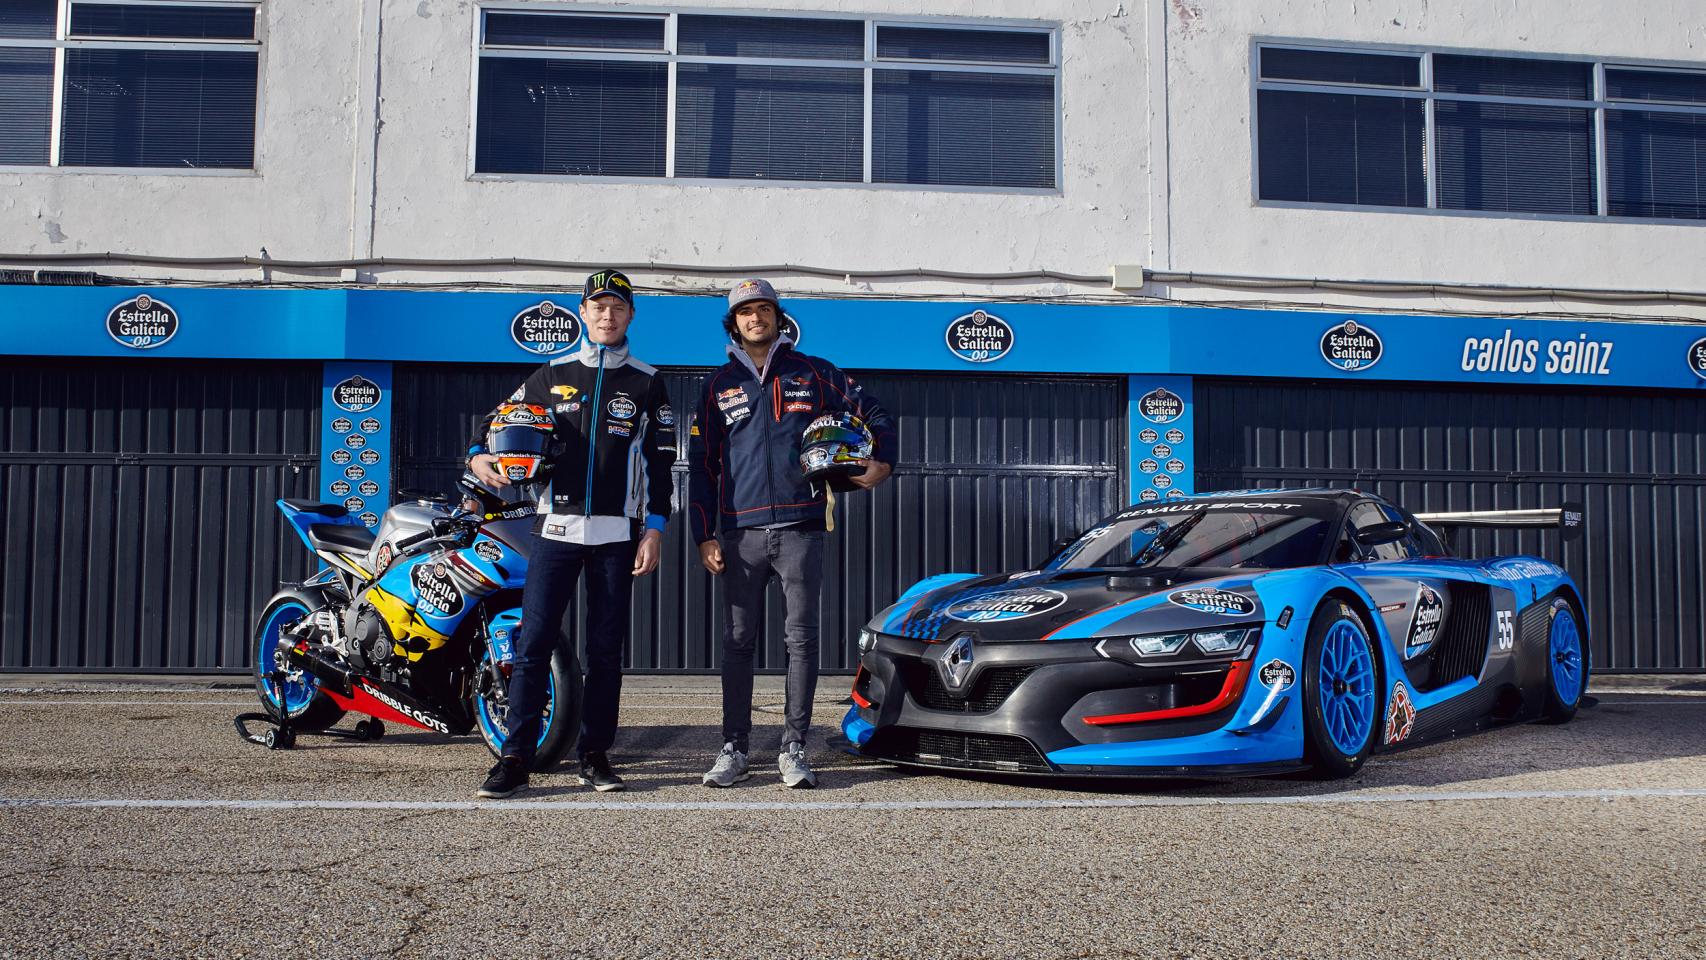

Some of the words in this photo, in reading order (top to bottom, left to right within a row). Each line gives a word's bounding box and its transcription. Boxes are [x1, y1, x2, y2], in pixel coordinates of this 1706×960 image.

[118, 309, 169, 323] Estrella
[522, 316, 572, 329] Estrella
[120, 322, 166, 336] Galicia
[524, 329, 569, 342] Galicia
[956, 324, 1004, 338] Estrella
[958, 337, 1002, 350] Galicia
[1329, 334, 1374, 347] Estrella
[1331, 346, 1372, 359] Galicia
[1461, 329, 1539, 373] carlos
[1545, 333, 1613, 375] sainz
[340, 386, 375, 395] Estrella
[784, 390, 811, 398] SAPINDA
[341, 395, 373, 404] Galicia
[1145, 398, 1178, 408] Estrella
[731, 407, 751, 418] NOVA
[1146, 406, 1176, 416] Galicia
[1117, 503, 1210, 519] RENAULT
[417, 564, 457, 603] Estrella
[1180, 591, 1245, 604] Estrella
[1184, 597, 1243, 611] Galicia
[961, 602, 1035, 613] Galicia
[1496, 610, 1515, 650] 55
[1264, 667, 1292, 676] Estrella
[362, 682, 412, 717] DRIBBLE
